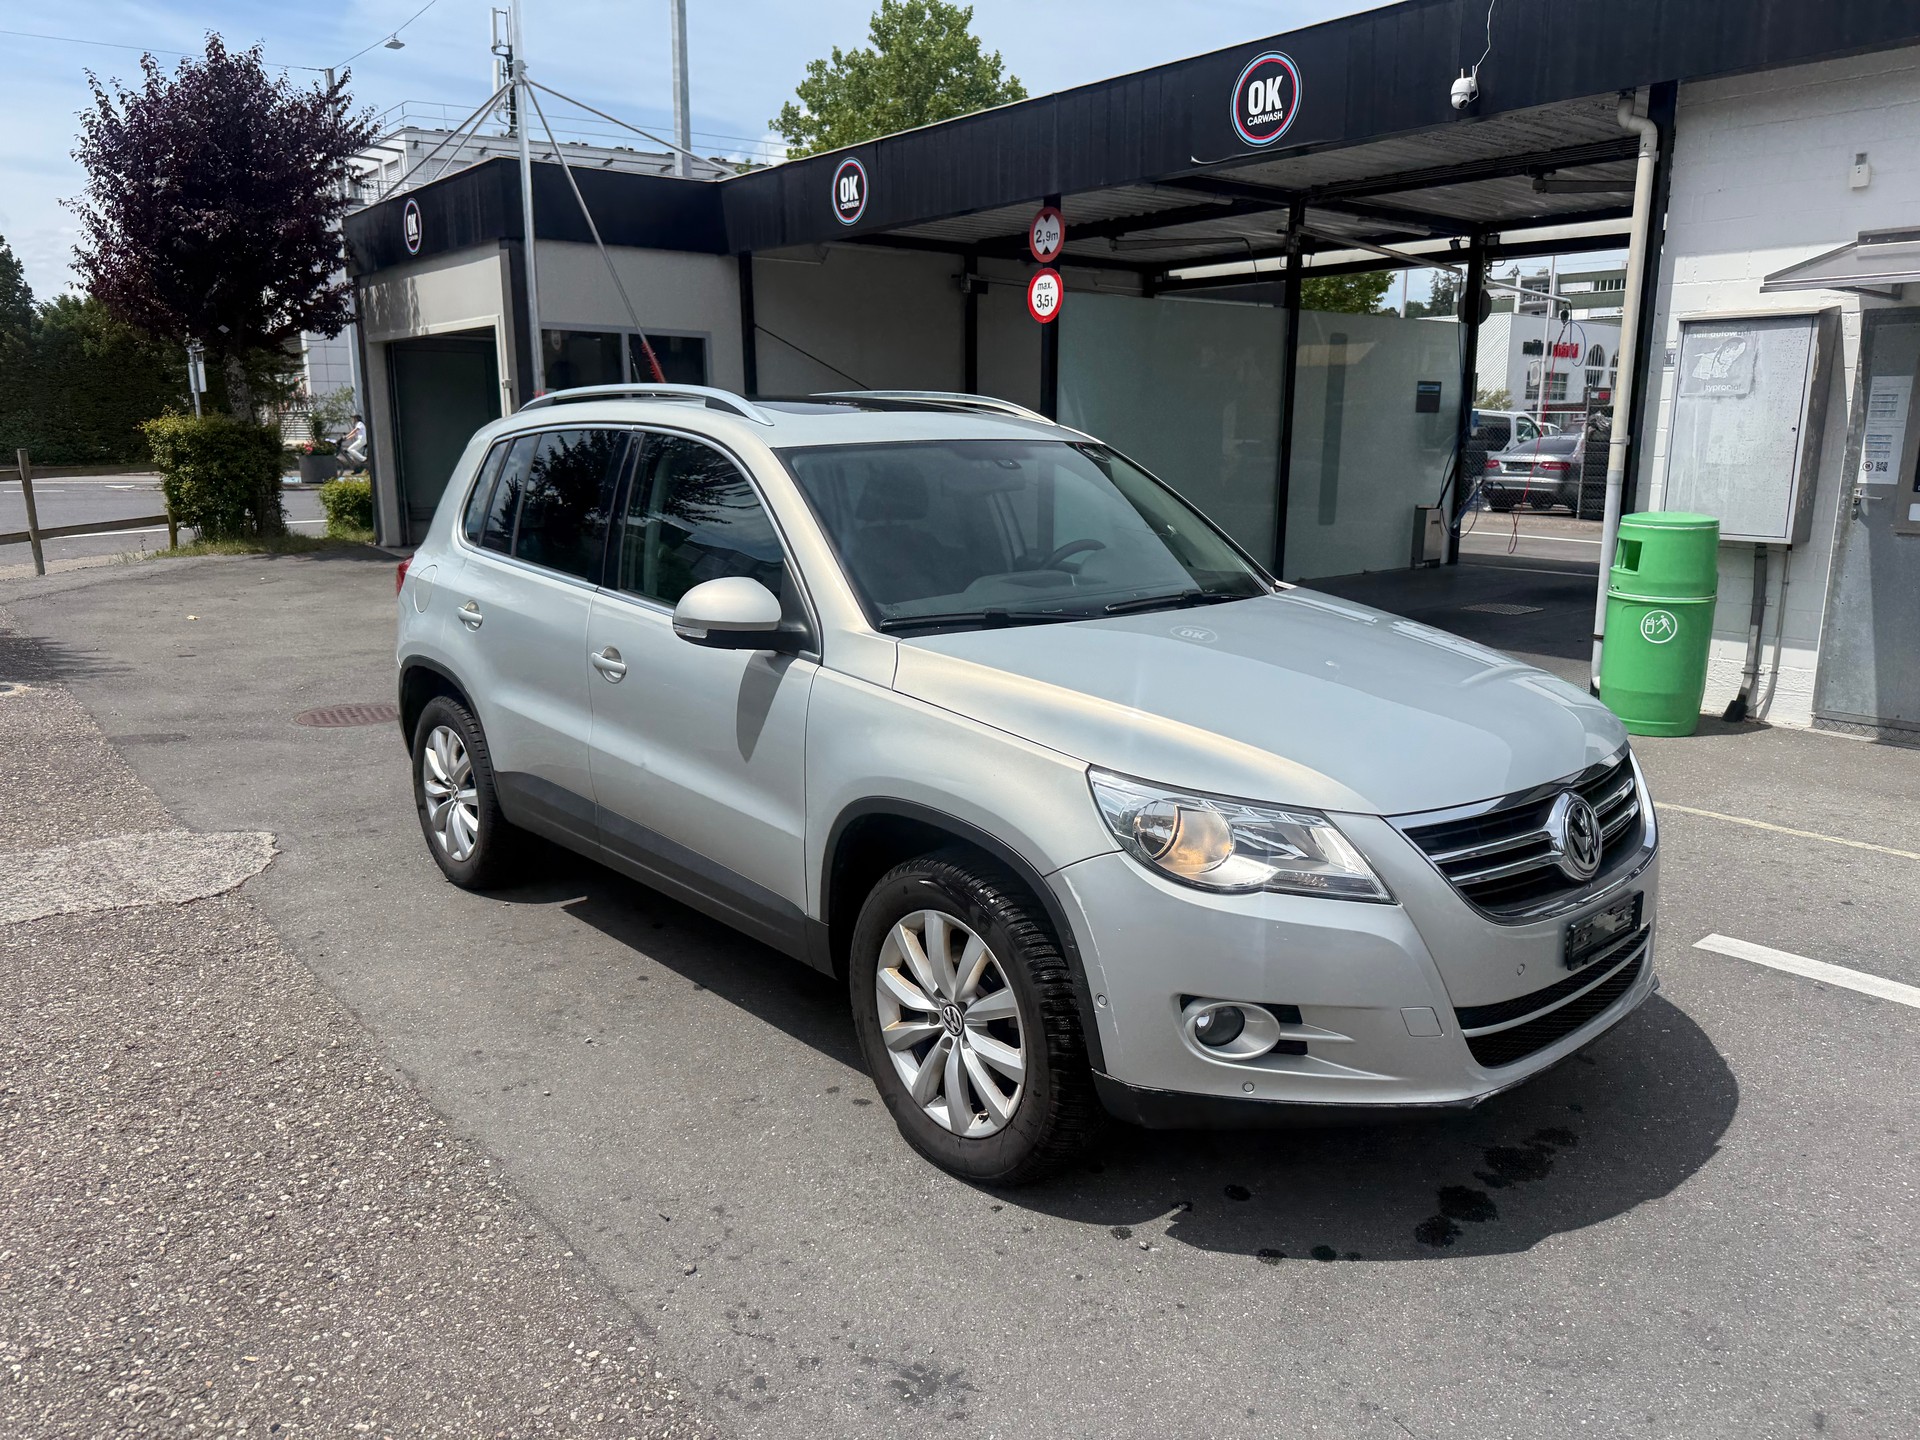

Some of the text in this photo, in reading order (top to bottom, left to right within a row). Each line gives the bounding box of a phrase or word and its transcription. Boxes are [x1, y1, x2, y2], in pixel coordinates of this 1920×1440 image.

[1248, 75, 1283, 115] OK
[1247, 110, 1283, 126] CARWASH
[840, 175, 859, 203] OK
[407, 213, 418, 235] OK
[1037, 282, 1053, 291] max.
